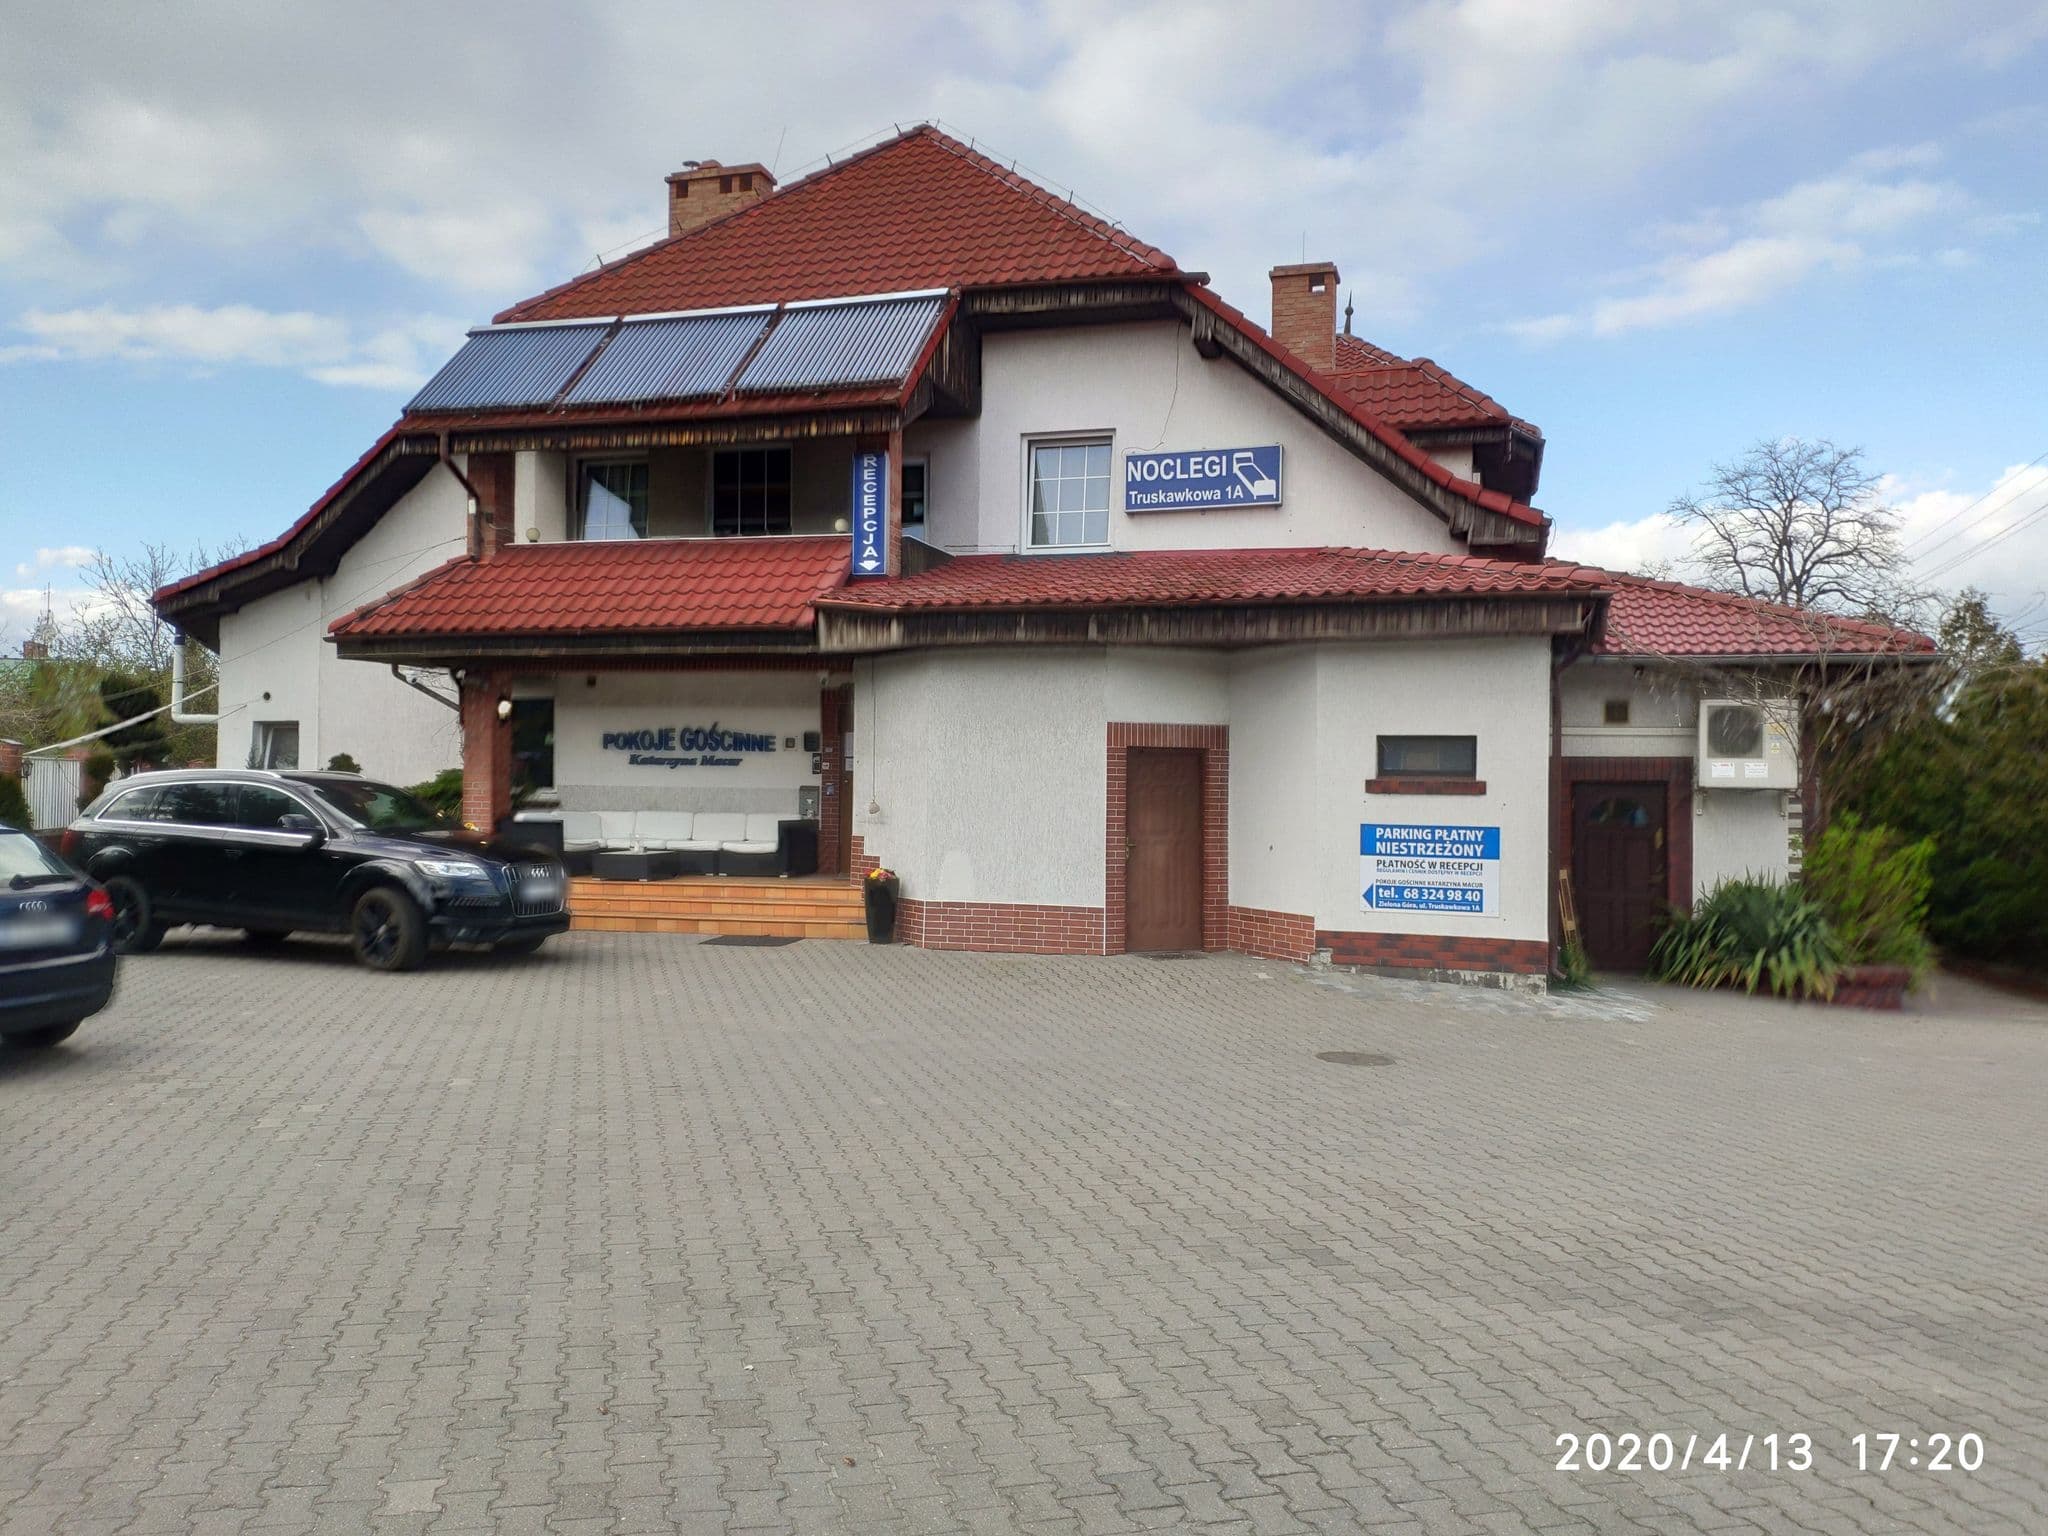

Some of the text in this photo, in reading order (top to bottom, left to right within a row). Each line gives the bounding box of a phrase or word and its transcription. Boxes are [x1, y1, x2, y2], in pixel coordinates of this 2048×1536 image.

[1127, 455, 1227, 482] NOCLEGI
[1129, 484, 1244, 505] Truskawkowa 1A
[862, 454, 879, 557] RECEPCJA
[602, 721, 777, 752] POKOJE GOŚCINNE
[1375, 827, 1484, 842] PARKING PŁATNY
[1375, 840, 1484, 857] NIESTRZEŻONY
[1376, 859, 1484, 871] PŁATNOŚĆ W RECEPCJI
[1378, 887, 1481, 901] tel. 68 324 98 40
